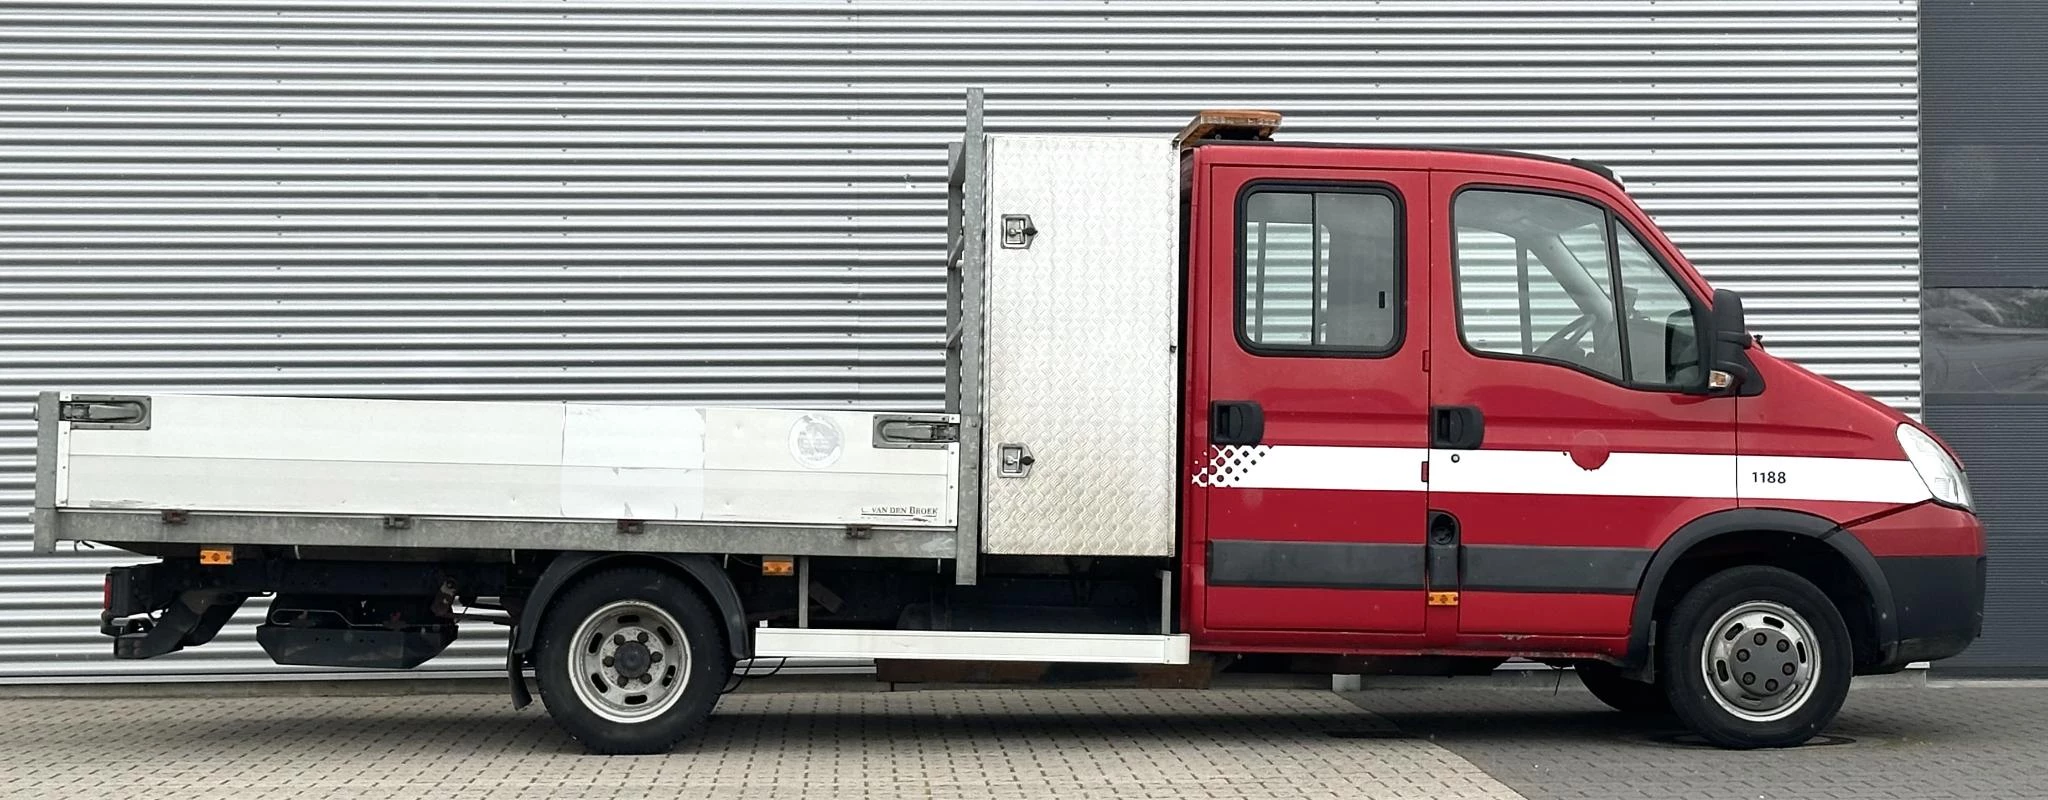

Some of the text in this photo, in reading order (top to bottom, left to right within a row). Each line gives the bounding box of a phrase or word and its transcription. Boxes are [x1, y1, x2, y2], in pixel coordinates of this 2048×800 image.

[1752, 471, 1786, 484] 1188
[871, 506, 888, 514] VAN
[889, 506, 907, 514] DEN
